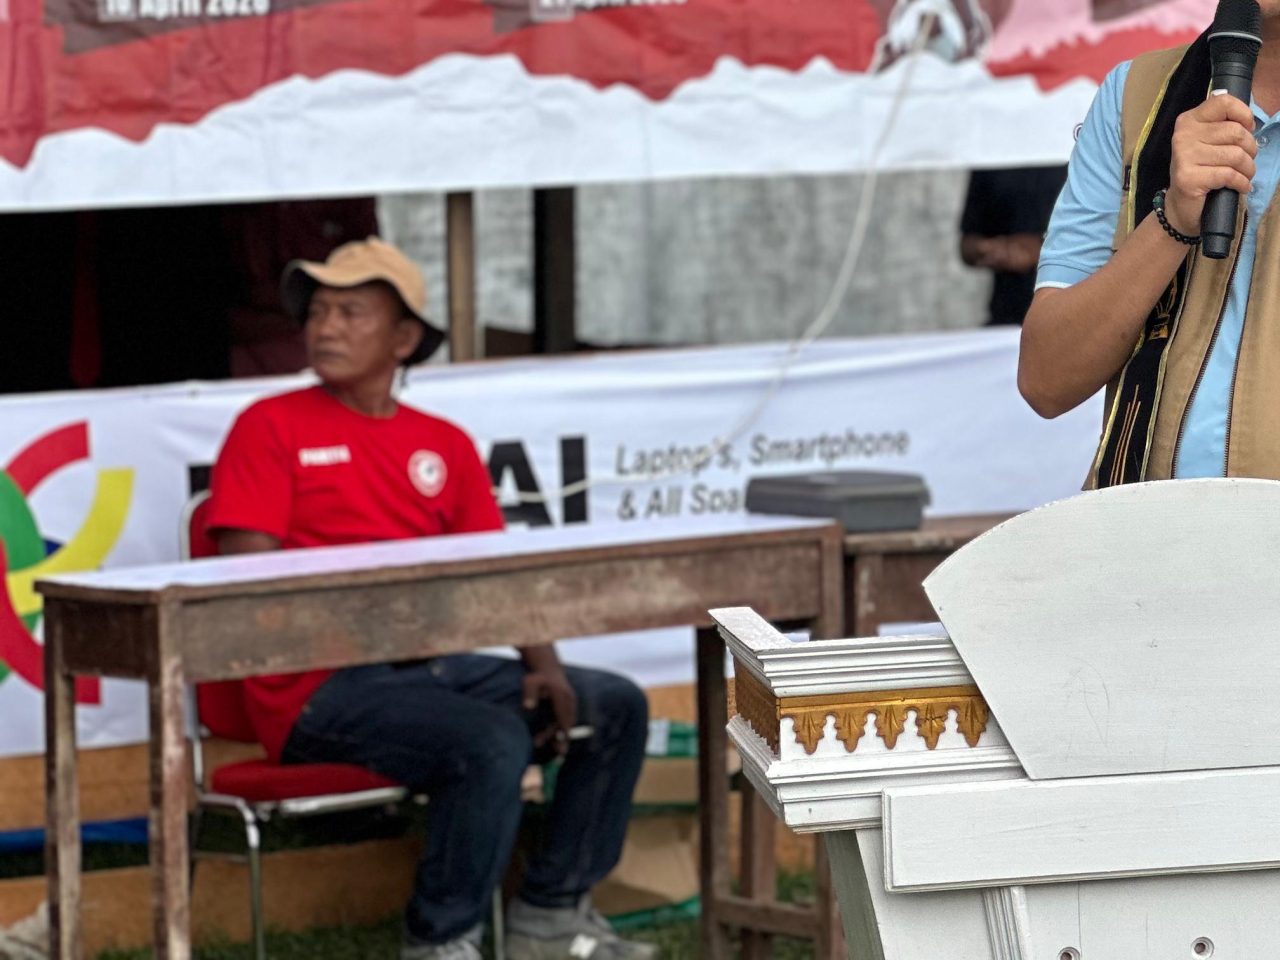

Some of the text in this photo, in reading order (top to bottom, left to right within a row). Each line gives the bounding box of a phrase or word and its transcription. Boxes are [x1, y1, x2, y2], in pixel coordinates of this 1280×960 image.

[749, 429, 909, 467] Smartphone
[617, 488, 637, 520] &
[644, 485, 683, 518] All
